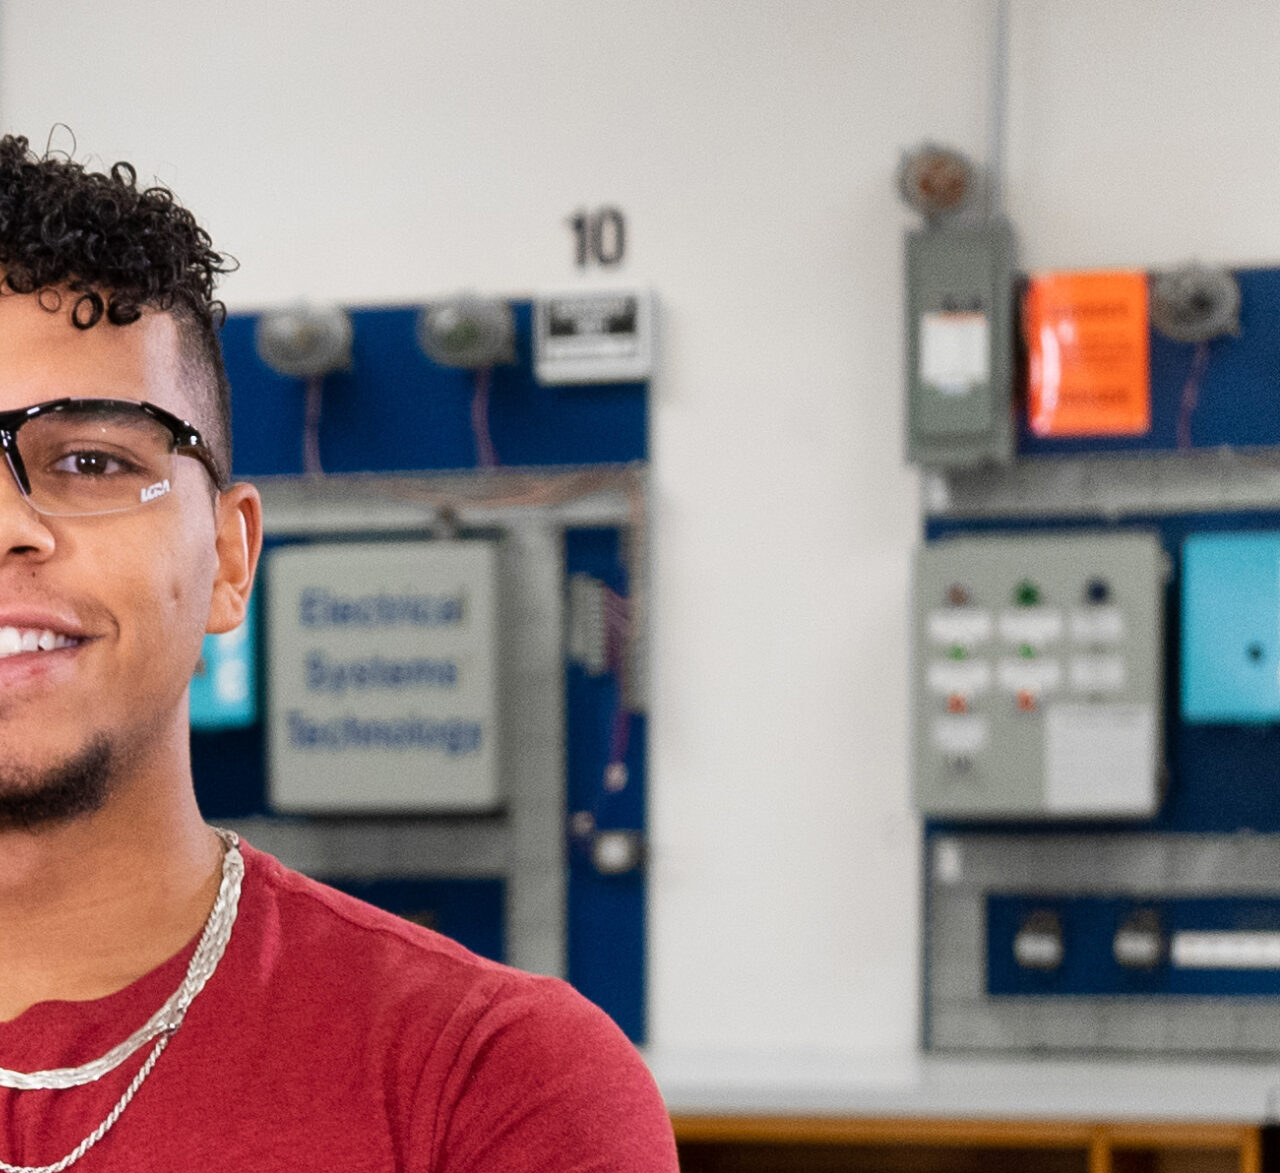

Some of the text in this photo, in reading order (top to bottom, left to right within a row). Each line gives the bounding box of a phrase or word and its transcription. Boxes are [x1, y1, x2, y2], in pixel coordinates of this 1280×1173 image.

[566, 206, 627, 274] 10
[298, 585, 468, 631] Electrical
[305, 650, 458, 697] Systems
[286, 712, 483, 759] Technology
